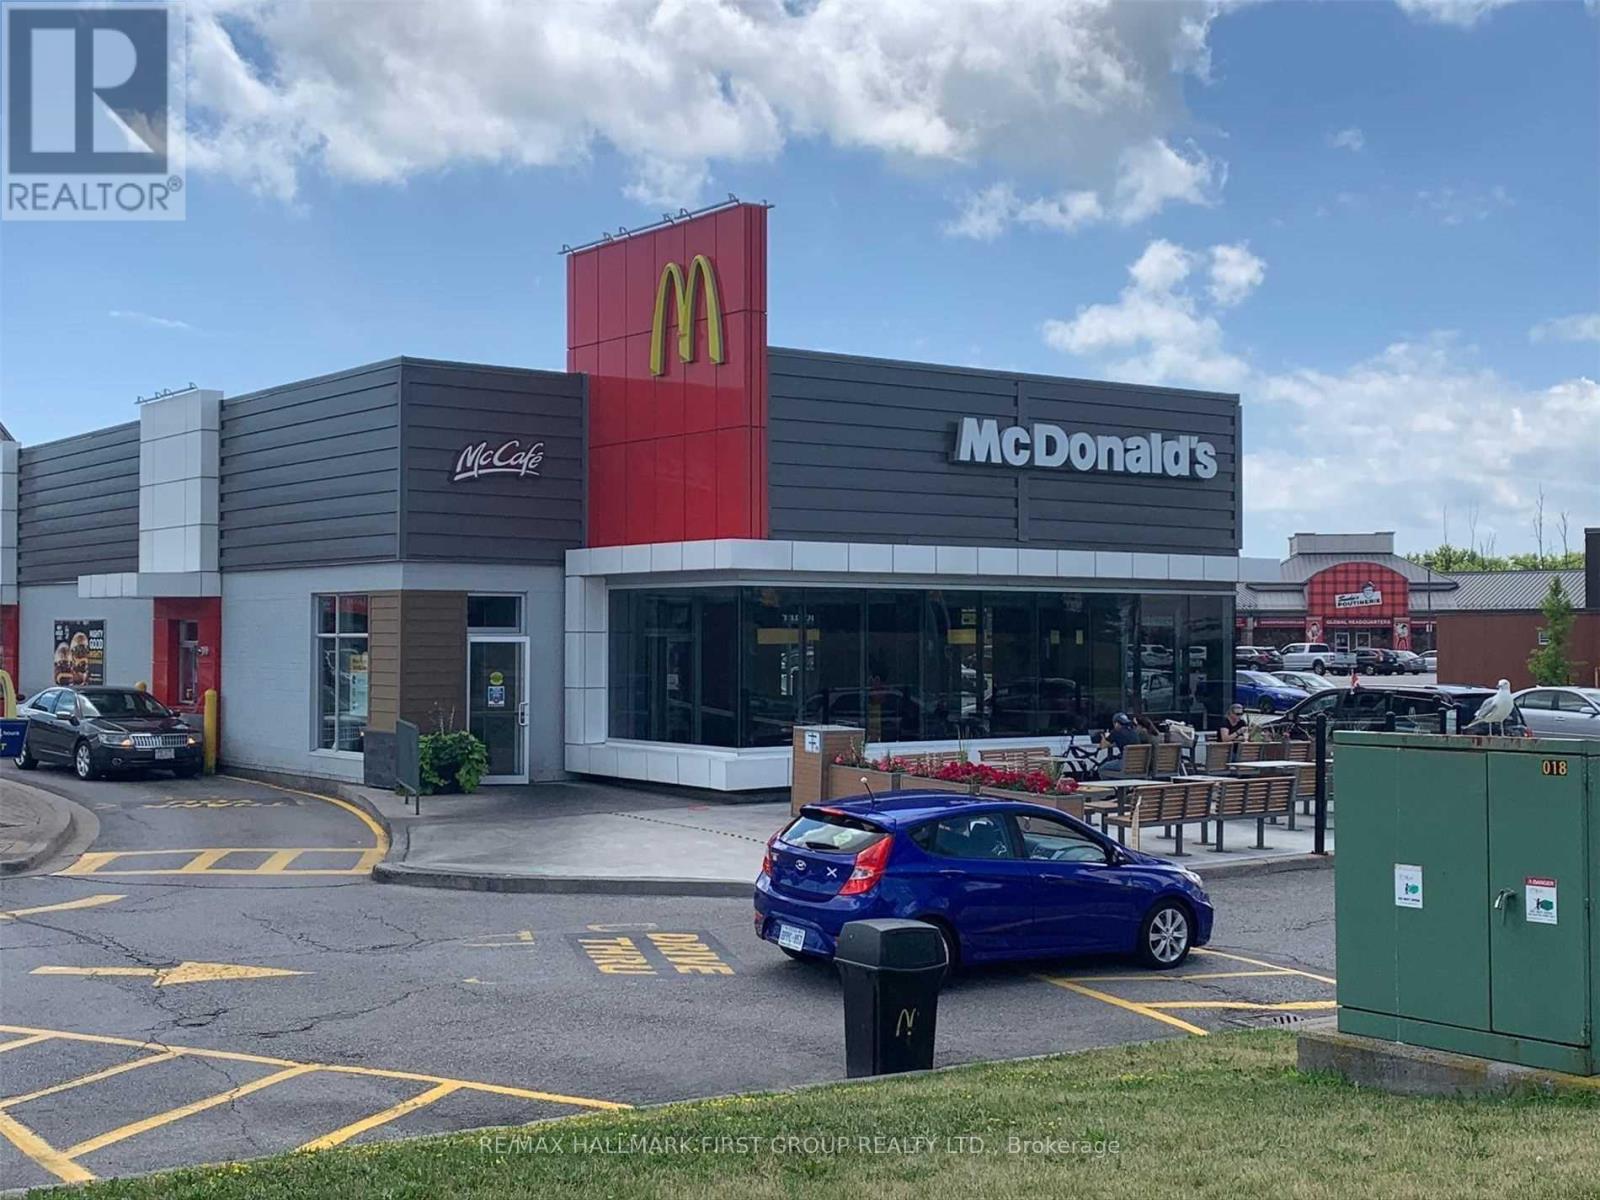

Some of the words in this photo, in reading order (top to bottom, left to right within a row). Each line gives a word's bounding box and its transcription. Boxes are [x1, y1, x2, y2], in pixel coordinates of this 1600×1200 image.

[455, 440, 544, 479] McCafé
[956, 417, 1218, 479] McDonald's
[1543, 760, 1567, 775] 018
